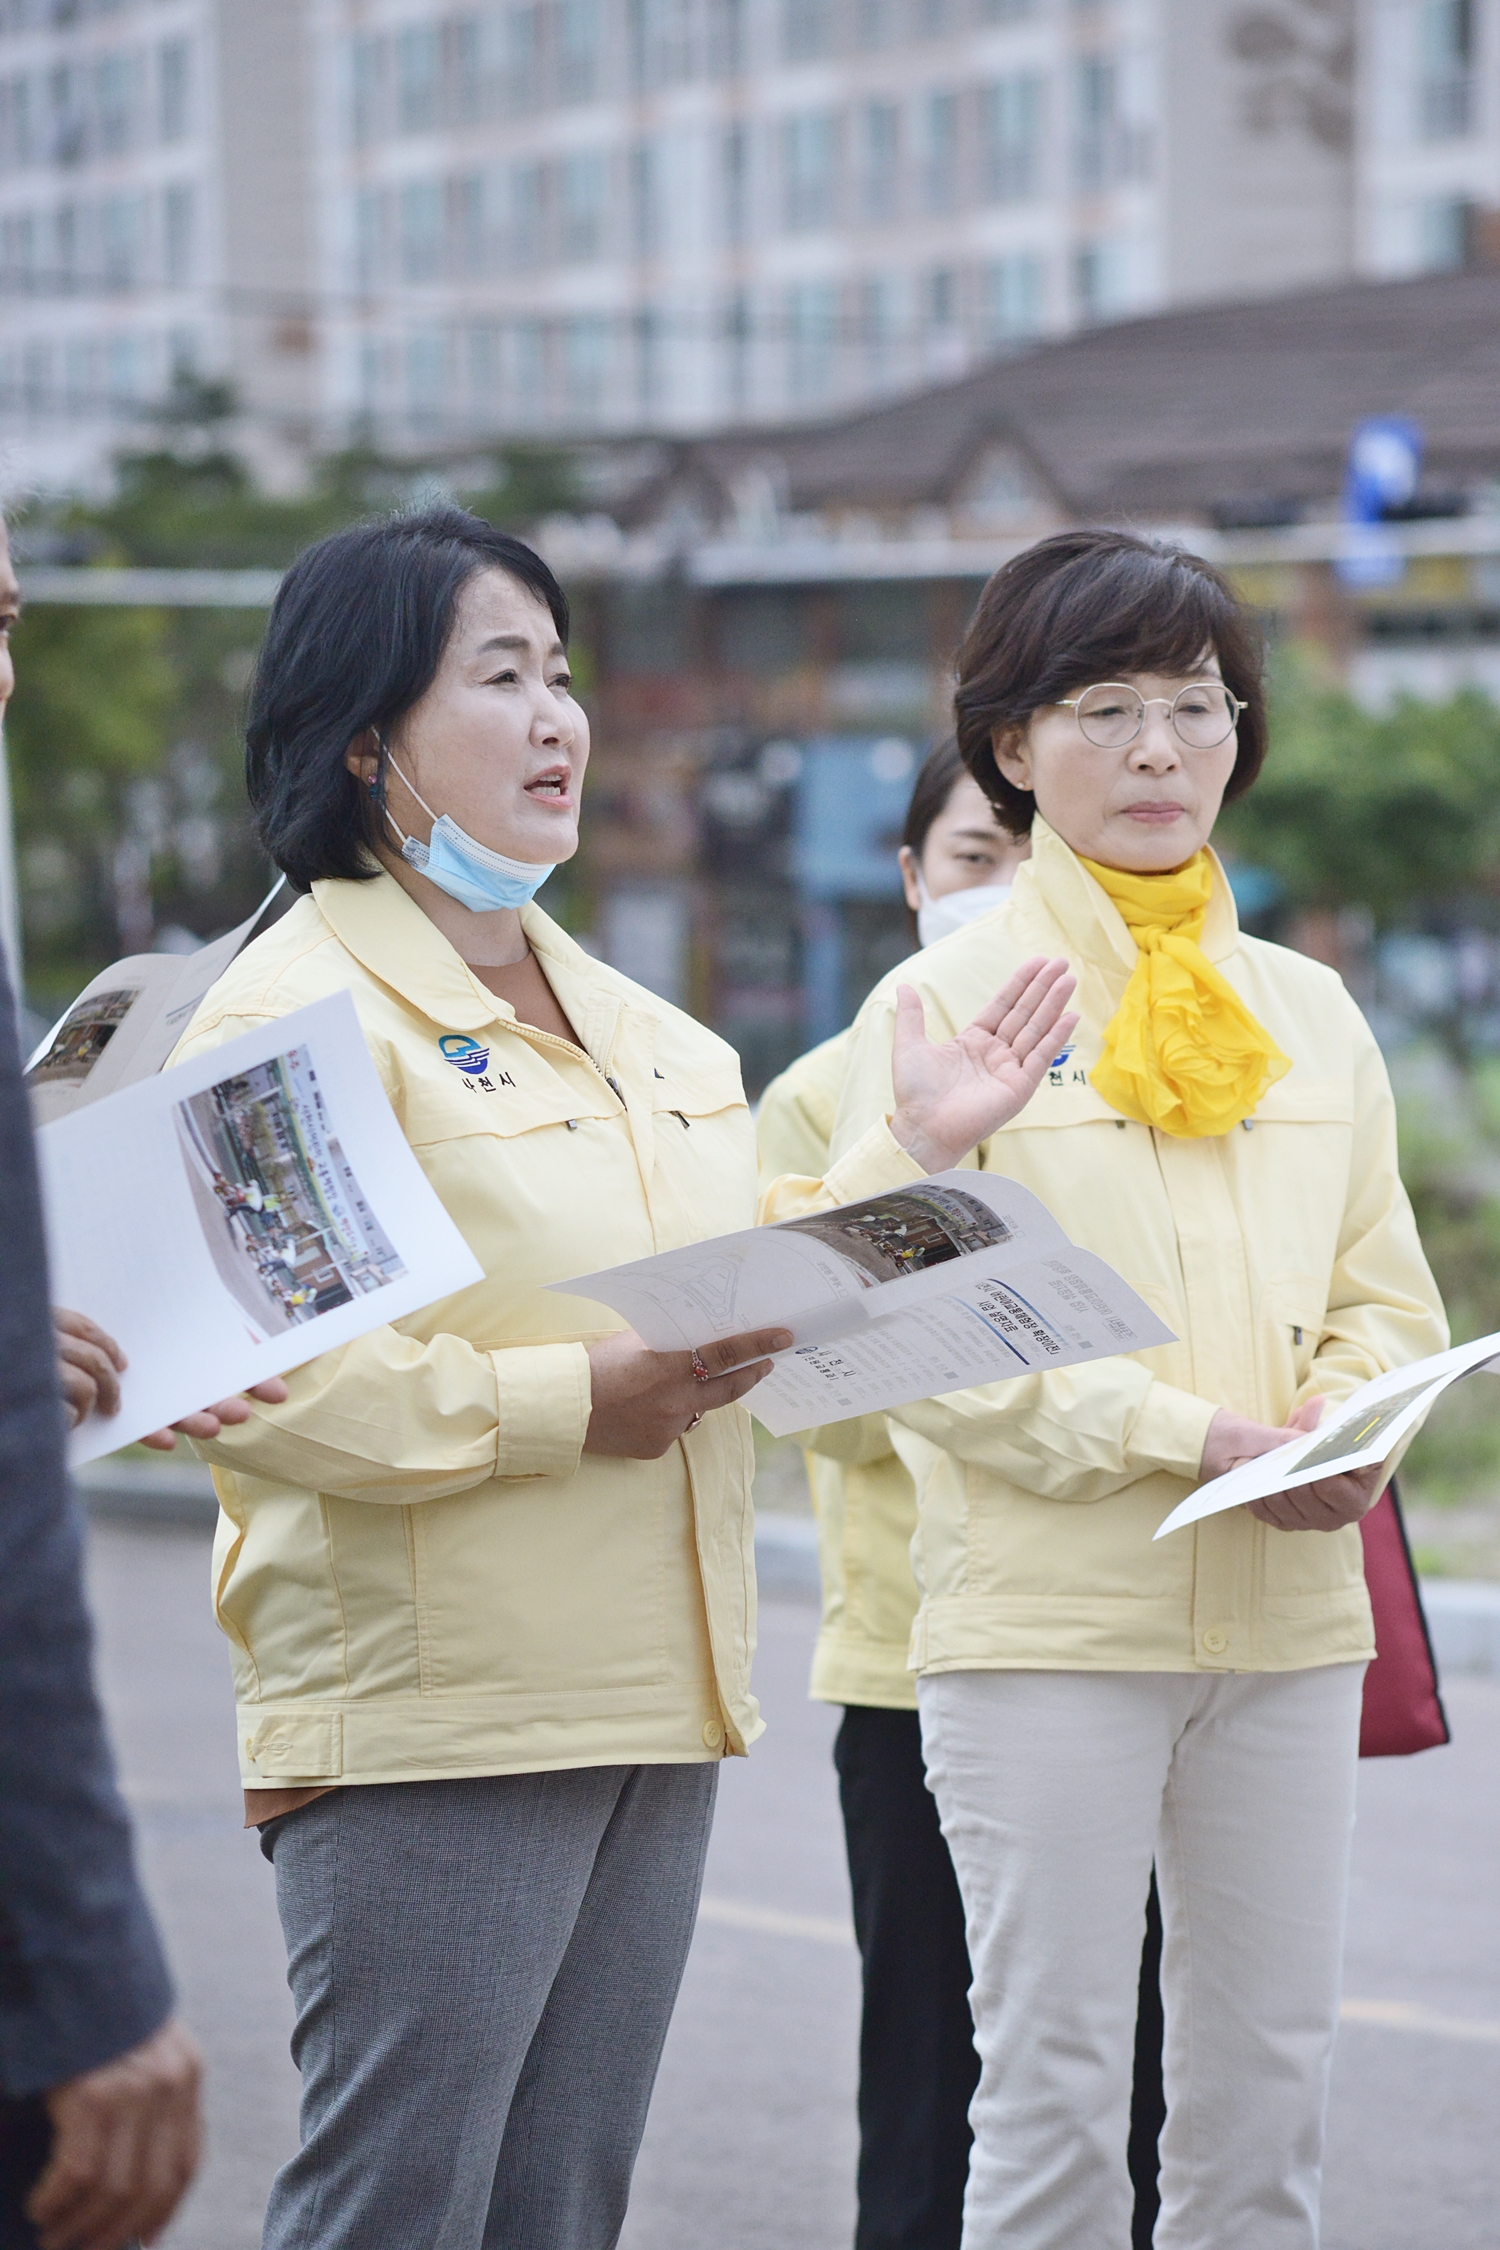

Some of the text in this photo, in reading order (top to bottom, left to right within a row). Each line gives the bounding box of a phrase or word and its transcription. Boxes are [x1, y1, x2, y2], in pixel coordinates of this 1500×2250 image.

[1048, 1069, 1086, 1087] 천시
[976, 1300, 1019, 1333] 사업 설명자료
[990, 1290, 1039, 1330] 어린이교통체험장
